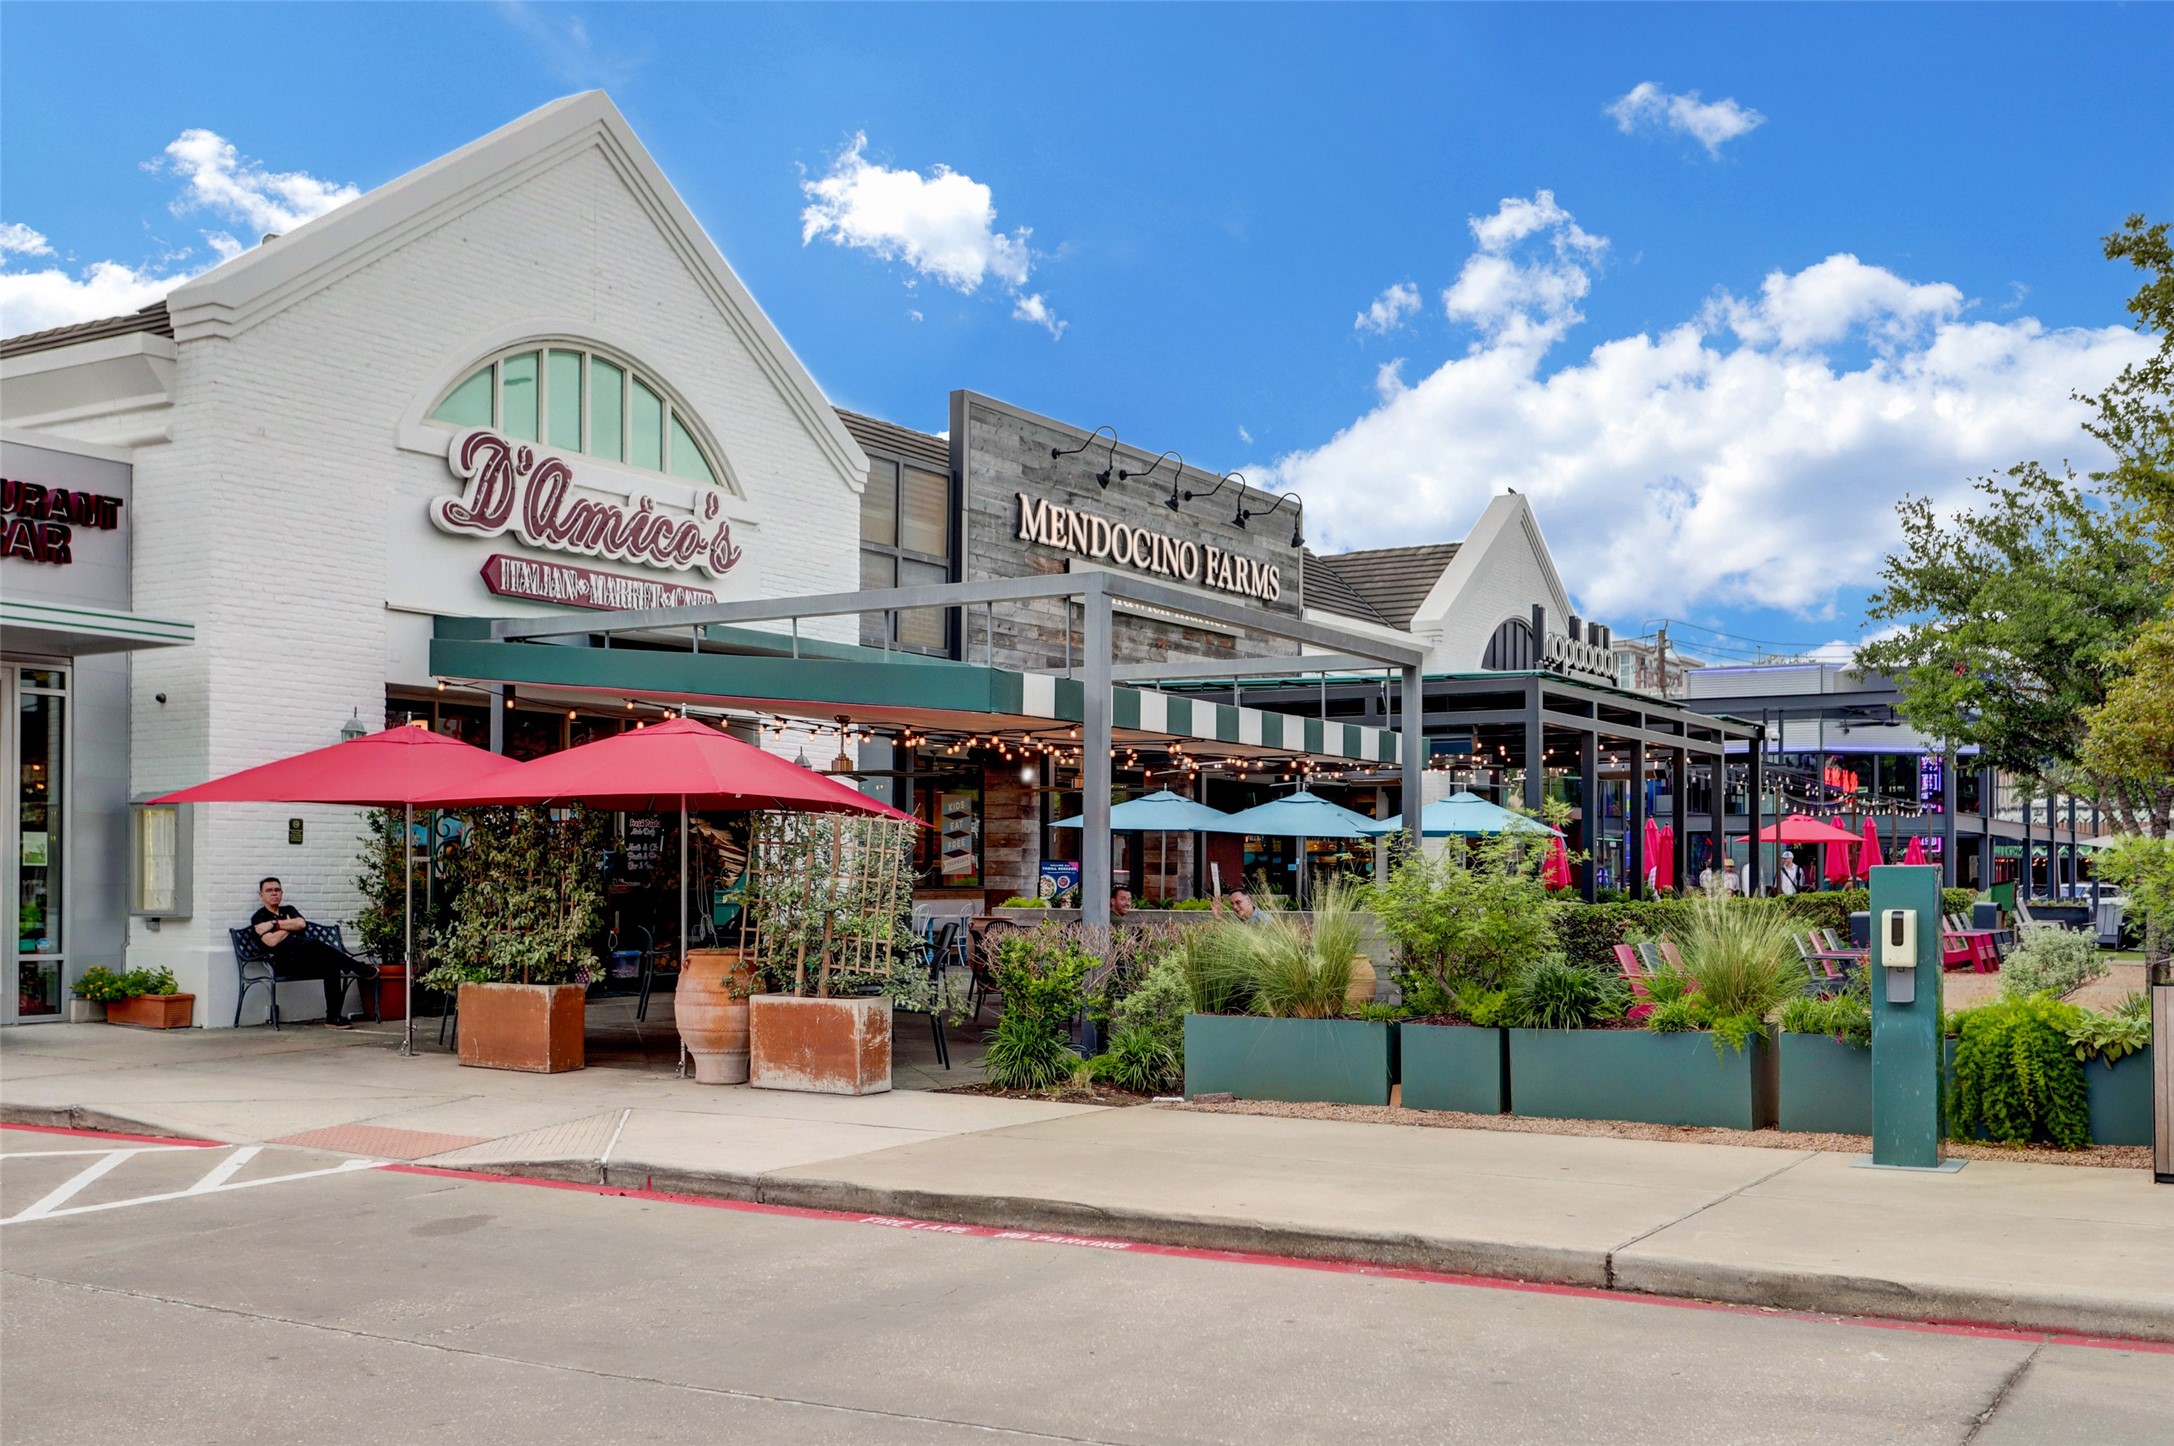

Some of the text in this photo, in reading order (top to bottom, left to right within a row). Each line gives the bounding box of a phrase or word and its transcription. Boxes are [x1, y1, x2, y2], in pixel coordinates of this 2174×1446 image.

[441, 430, 742, 575] D'Amico's
[1017, 492, 1280, 601] MENDOCINO FARMS
[500, 558, 578, 601] ITALIAN
[589, 573, 664, 610] MARKET
[948, 800, 965, 812] KIDS
[949, 820, 964, 831] EAT
[947, 839, 966, 849] FREE
[860, 1217, 1132, 1250] FIRE LANE NO PARKING
